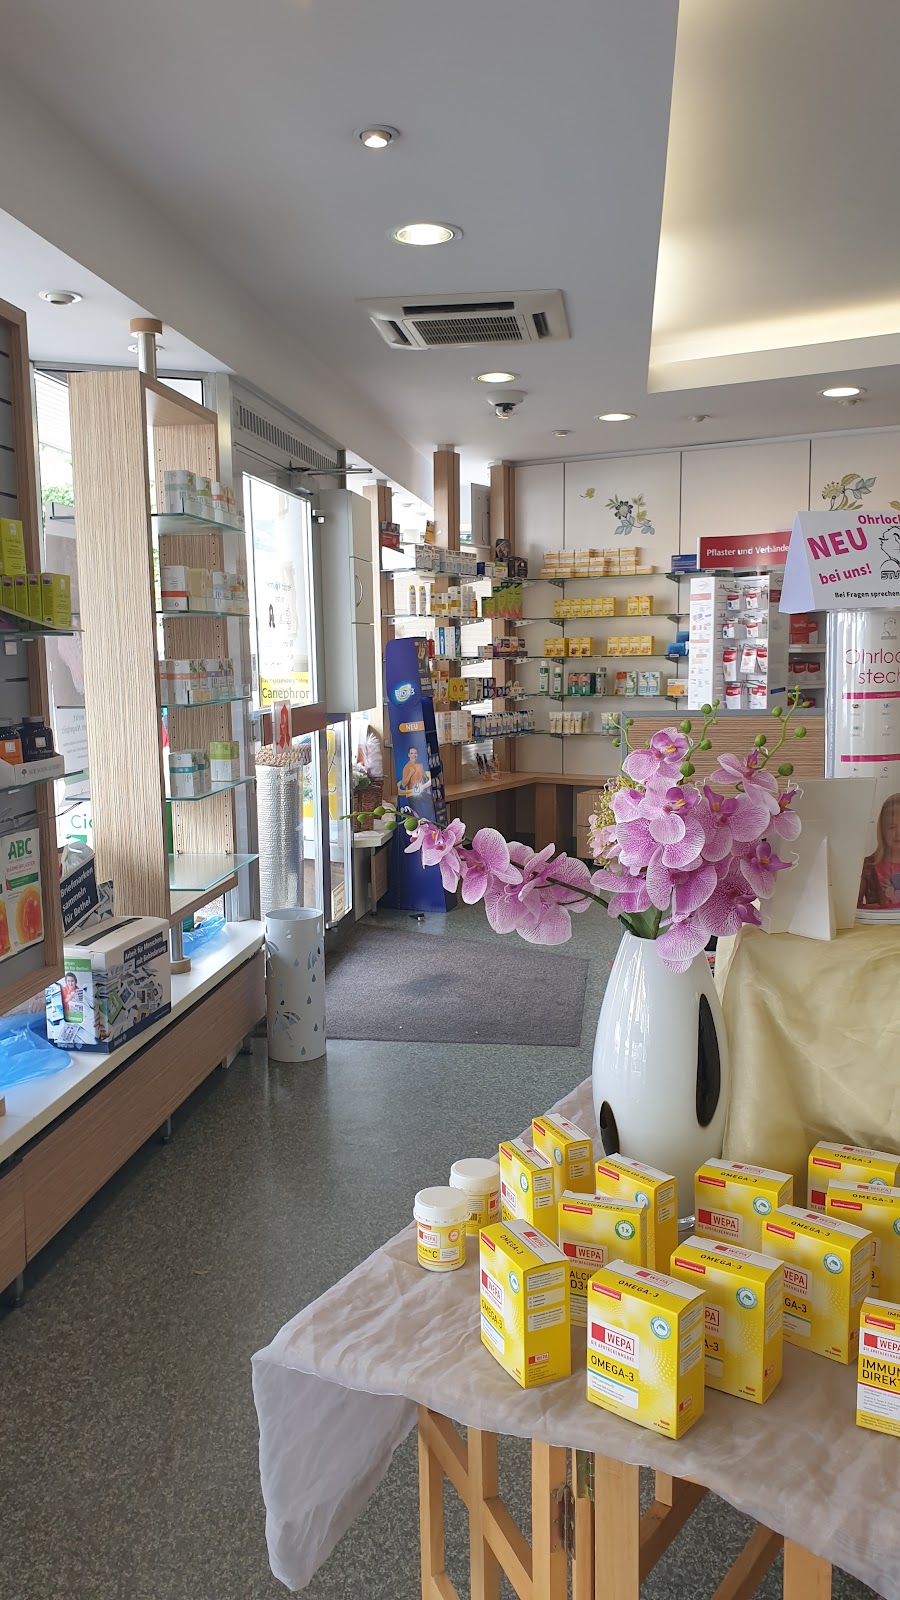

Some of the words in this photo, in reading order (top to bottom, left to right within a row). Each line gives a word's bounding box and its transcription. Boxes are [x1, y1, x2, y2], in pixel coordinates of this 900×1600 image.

[706, 548, 736, 557] Pflaster
[737, 546, 753, 556] und
[806, 526, 868, 561] NEU
[818, 568, 842, 586] bei
[842, 562, 873, 580] uns!
[846, 590, 870, 600] Fragen
[405, 723, 419, 731] NEU
[7, 836, 32, 860] ABC
[60, 866, 94, 898] Briefmarken
[62, 886, 87, 912] sammeln
[64, 911, 74, 926] für
[73, 895, 91, 918] Bethel
[834, 1153, 872, 1164] OMEGA-3
[720, 1171, 758, 1183] OMEGA-3
[852, 1193, 894, 1204] OMEGA-3
[621, 1226, 630, 1234] 1x
[713, 1215, 736, 1229] WEPA
[790, 1221, 831, 1237] OMEGA-3
[500, 1234, 524, 1255] OMEGA-3
[432, 1250, 438, 1259] C
[578, 1248, 601, 1260] WEPA
[700, 1254, 743, 1270] OMEGA-3
[617, 1279, 660, 1299] OMEGA-3
[480, 1299, 503, 1330] OMEGA-3
[607, 1332, 632, 1352] WEPA
[590, 1355, 635, 1382] OMEGA-3
[862, 1369, 900, 1388] DIREK
